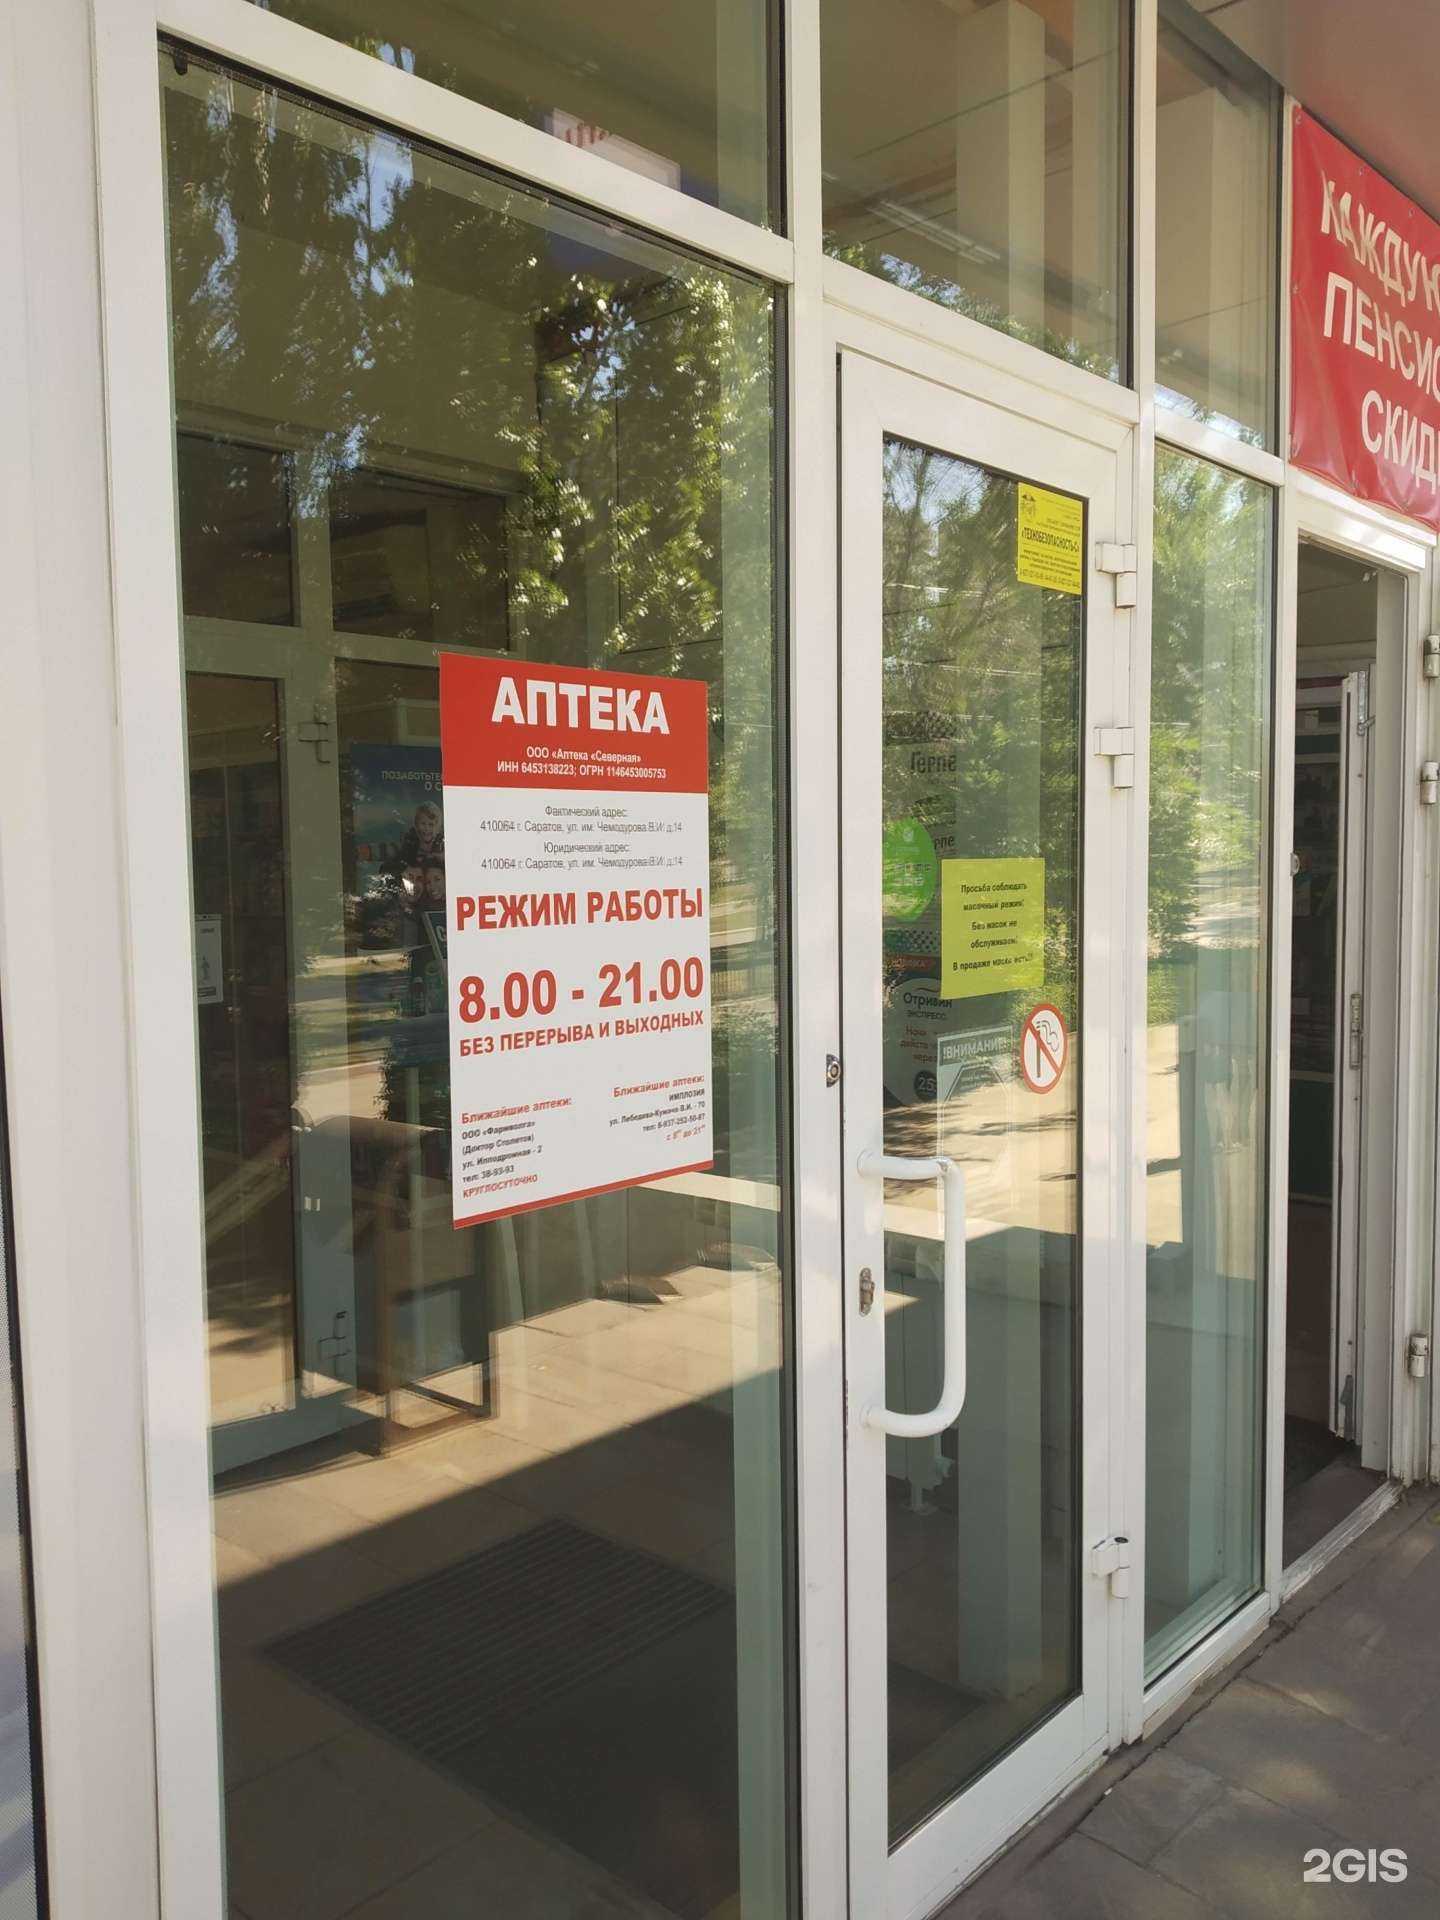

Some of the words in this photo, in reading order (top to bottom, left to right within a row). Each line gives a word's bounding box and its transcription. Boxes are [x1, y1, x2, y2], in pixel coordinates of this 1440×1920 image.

[1361, 389, 1440, 495] СКИД
[491, 676, 670, 735] АПТЕКА
[526, 746, 549, 759] ООО
[551, 748, 588, 761] «Аптека
[591, 750, 642, 764] «Северная»
[382, 770, 443, 781] ПОЗАБОТЬТЕ
[497, 760, 519, 773] ИНН
[579, 764, 604, 777] ОГРН
[544, 805, 600, 817] Фактический
[480, 820, 515, 832] 410064
[543, 841, 603, 855] Юридический
[481, 857, 516, 870] 410064
[961, 884, 991, 895] Просьба
[456, 892, 576, 931] РЕЖИМ
[587, 887, 703, 923] РАБОТЫ
[1008, 920, 1017, 928] не
[952, 962, 958, 971] В
[459, 969, 557, 1024] 8.00
[572, 989, 585, 1000] -
[598, 956, 704, 1008] 21.00
[459, 1035, 495, 1057] БЕЗ
[500, 1023, 595, 1052] ПЕРЕРЫВА
[599, 1021, 610, 1038] И
[615, 1010, 704, 1036] ВЫХОДНЫХ
[613, 1081, 670, 1098] Ближайшие
[462, 1104, 530, 1124] Ближайшие
[609, 1118, 619, 1127] ул.
[462, 1129, 481, 1140] ООО
[462, 1142, 495, 1156] (Доктор
[462, 1161, 475, 1171] ул.
[463, 1174, 539, 1199] КРУГЛОСУТОЧНО
